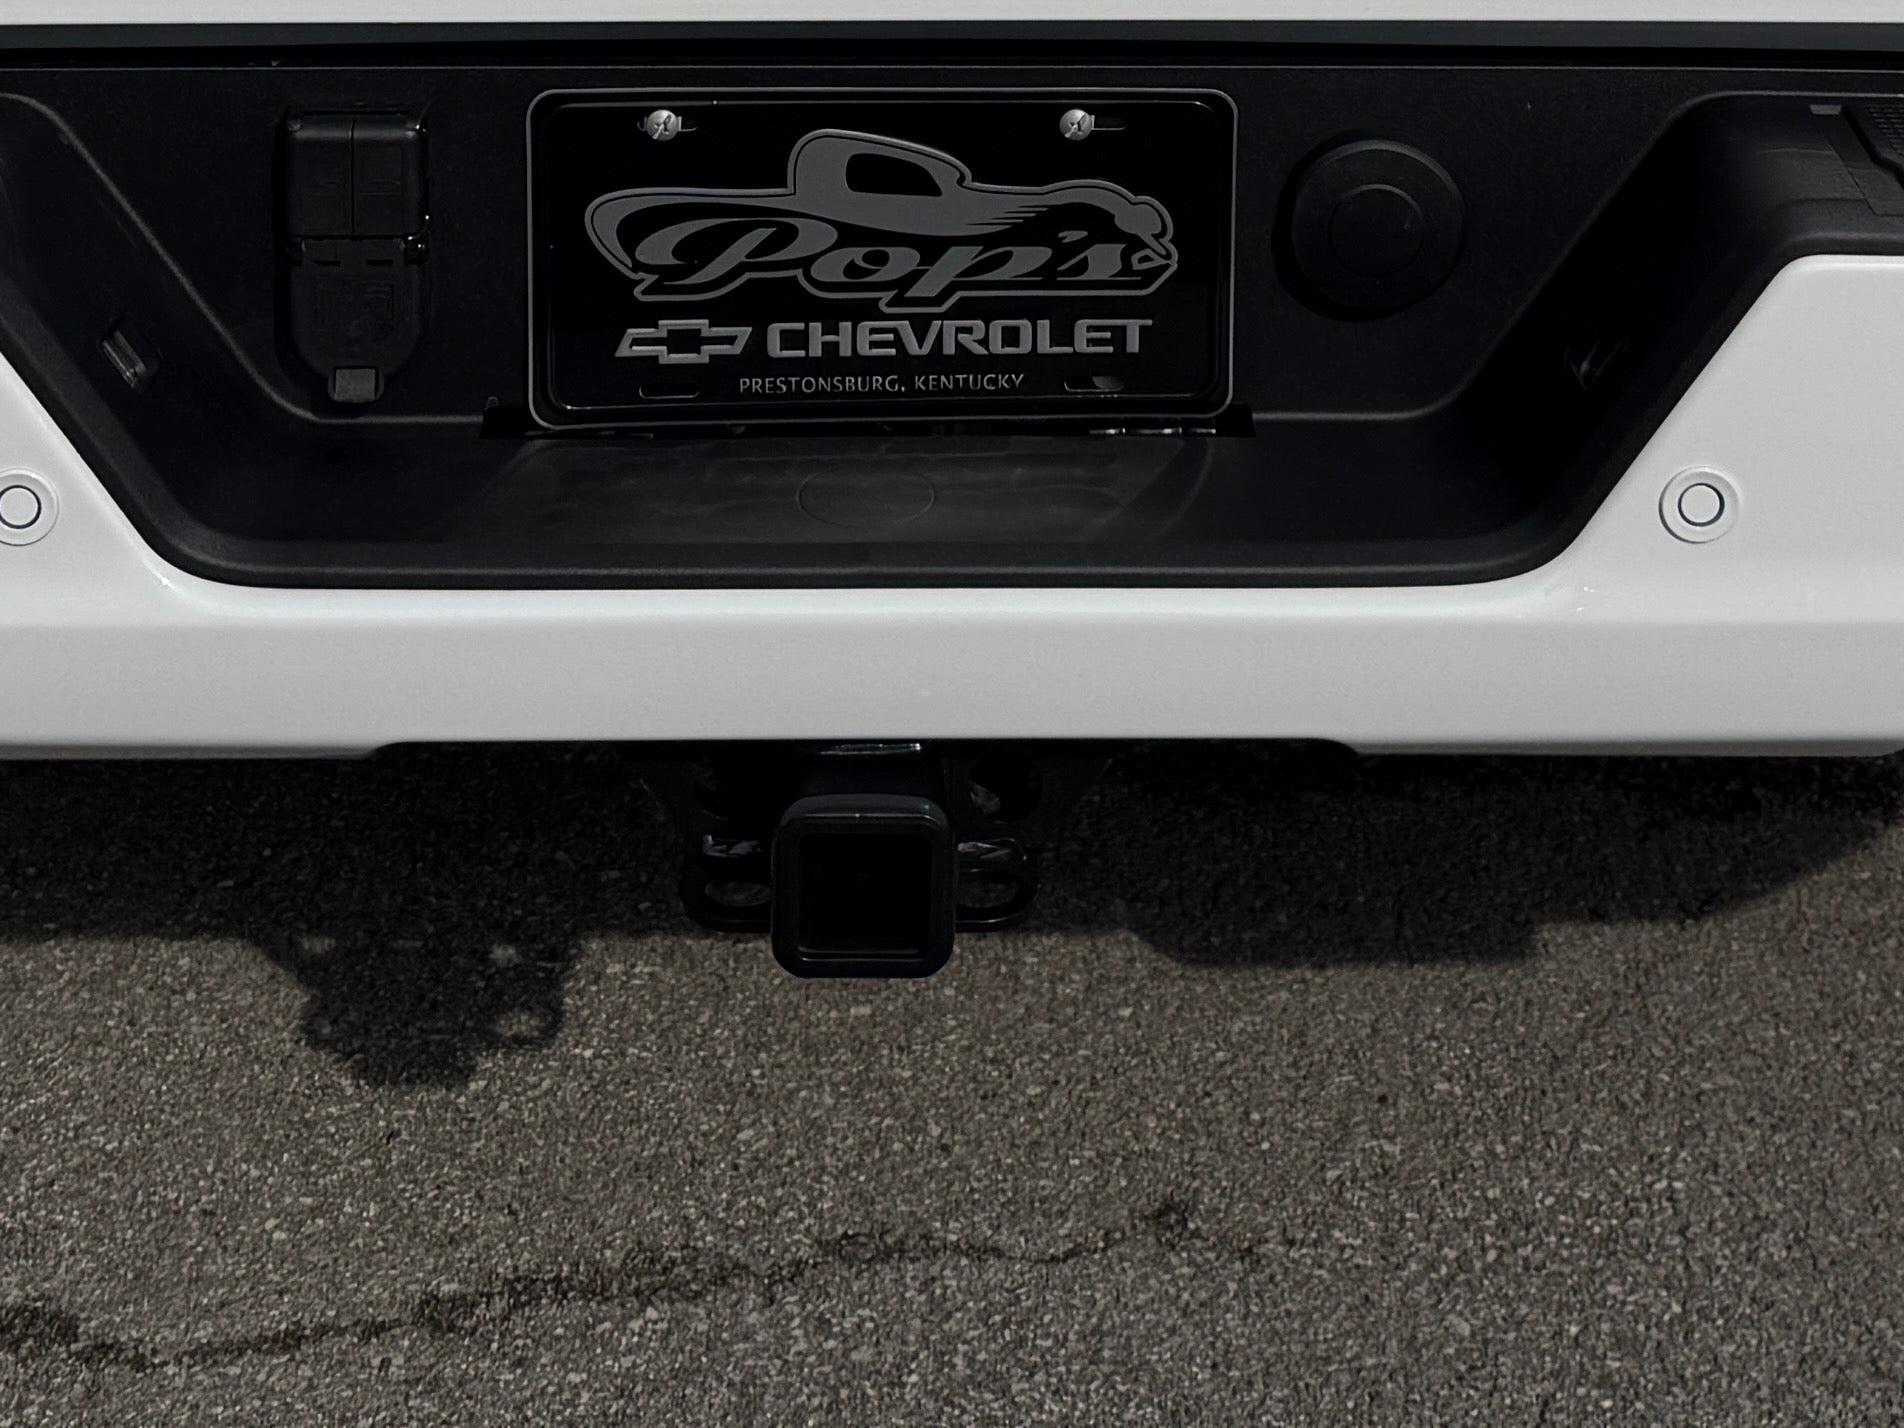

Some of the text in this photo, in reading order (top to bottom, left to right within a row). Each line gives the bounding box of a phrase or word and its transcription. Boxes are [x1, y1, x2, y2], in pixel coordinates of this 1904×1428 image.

[634, 217, 1142, 298] Pop's
[766, 317, 1154, 359] CHEVROLET
[738, 373, 1024, 395] PRESTONSBURG, KENTUCKY
